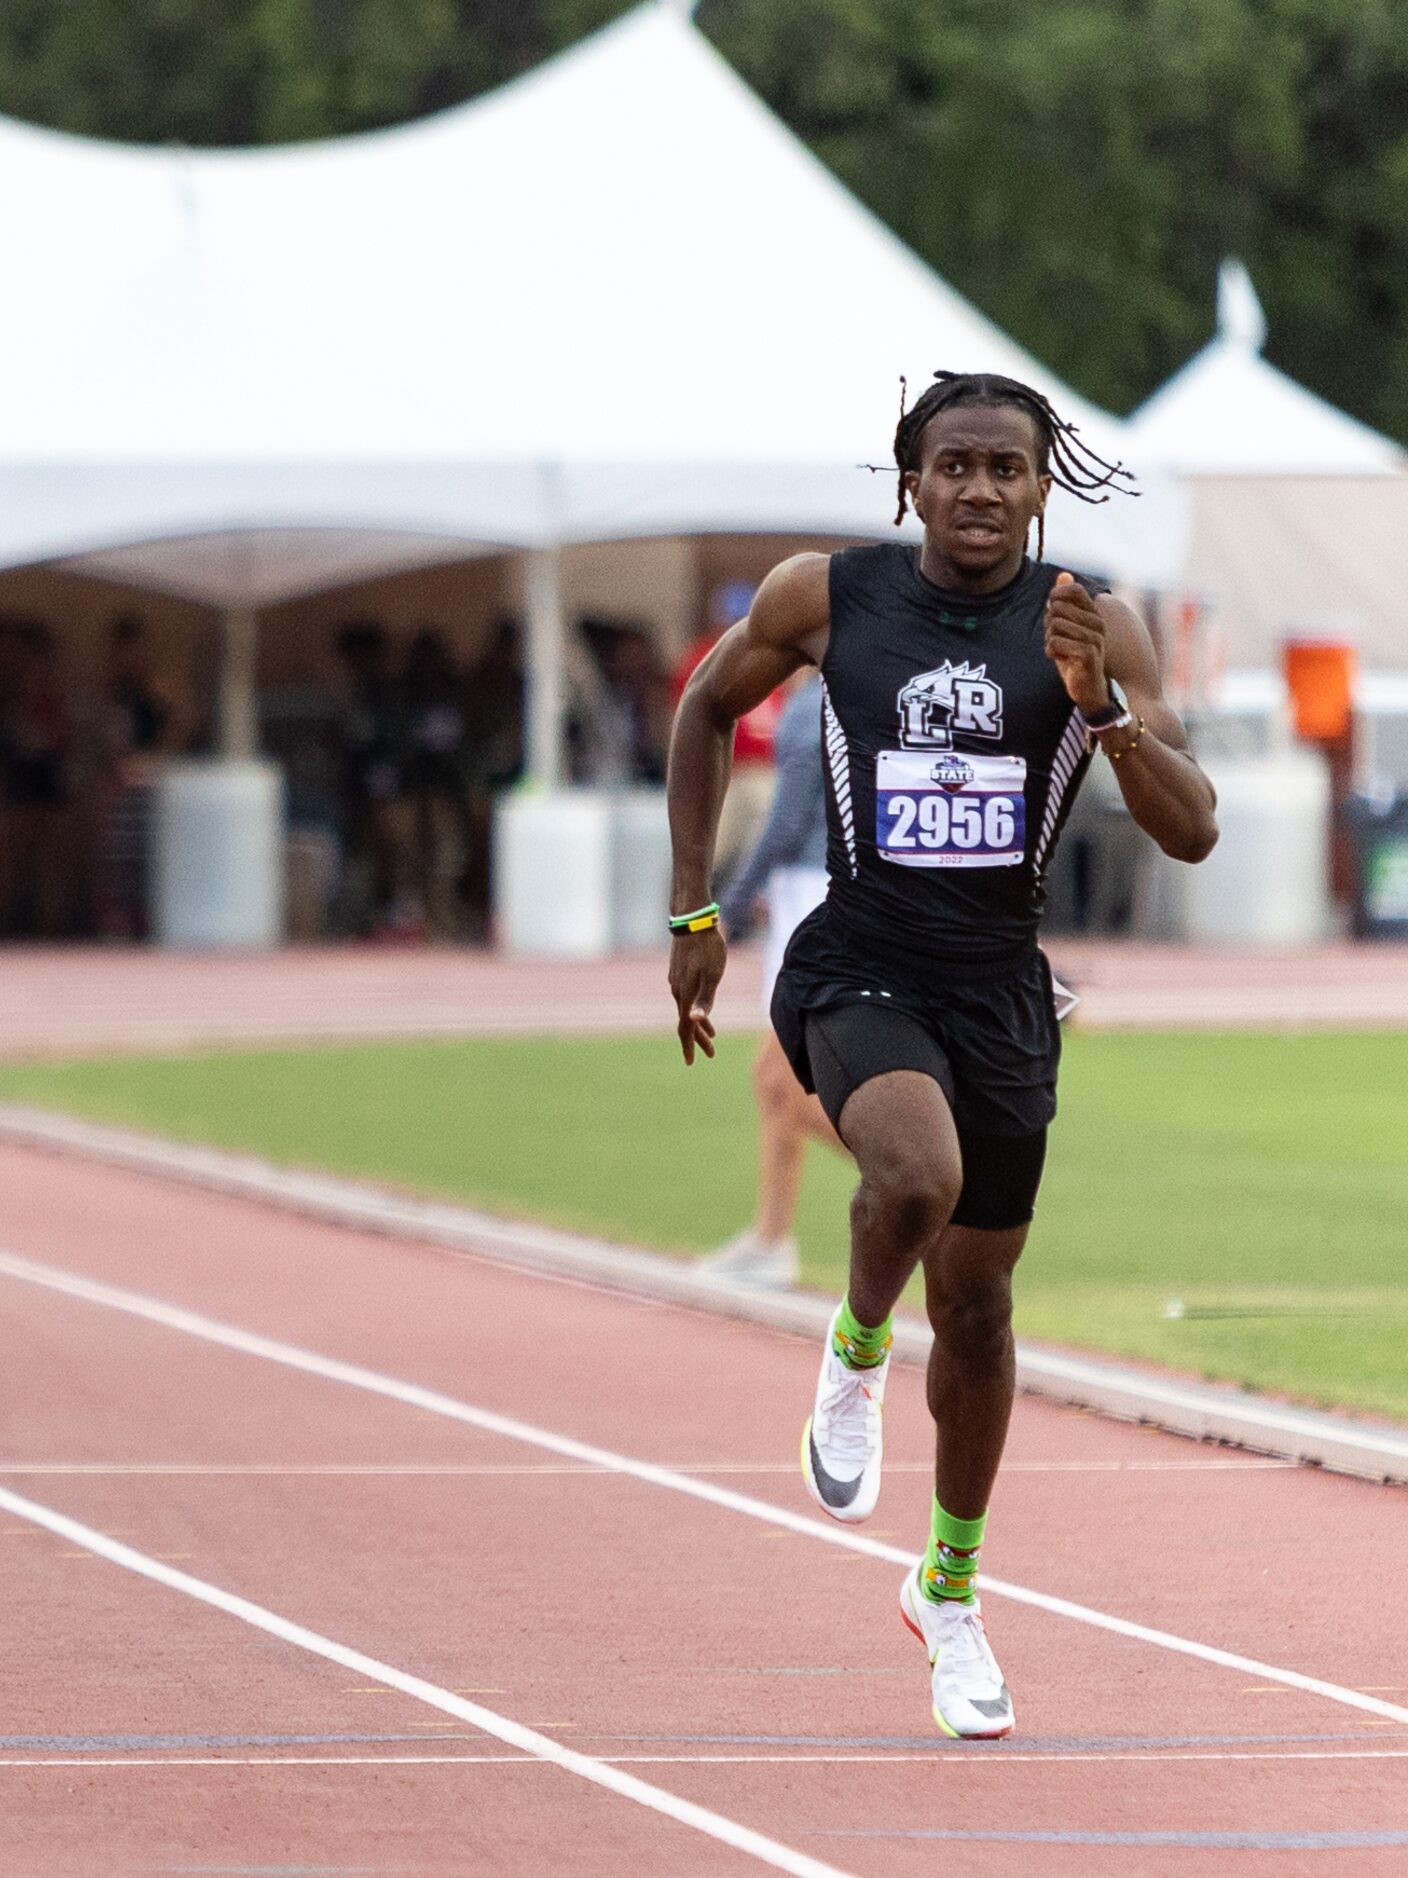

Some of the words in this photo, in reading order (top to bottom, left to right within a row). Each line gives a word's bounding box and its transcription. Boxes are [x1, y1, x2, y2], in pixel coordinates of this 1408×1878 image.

[930, 768, 974, 781] STATE
[886, 795, 1015, 849] 2956
[938, 855, 964, 865] 2022
